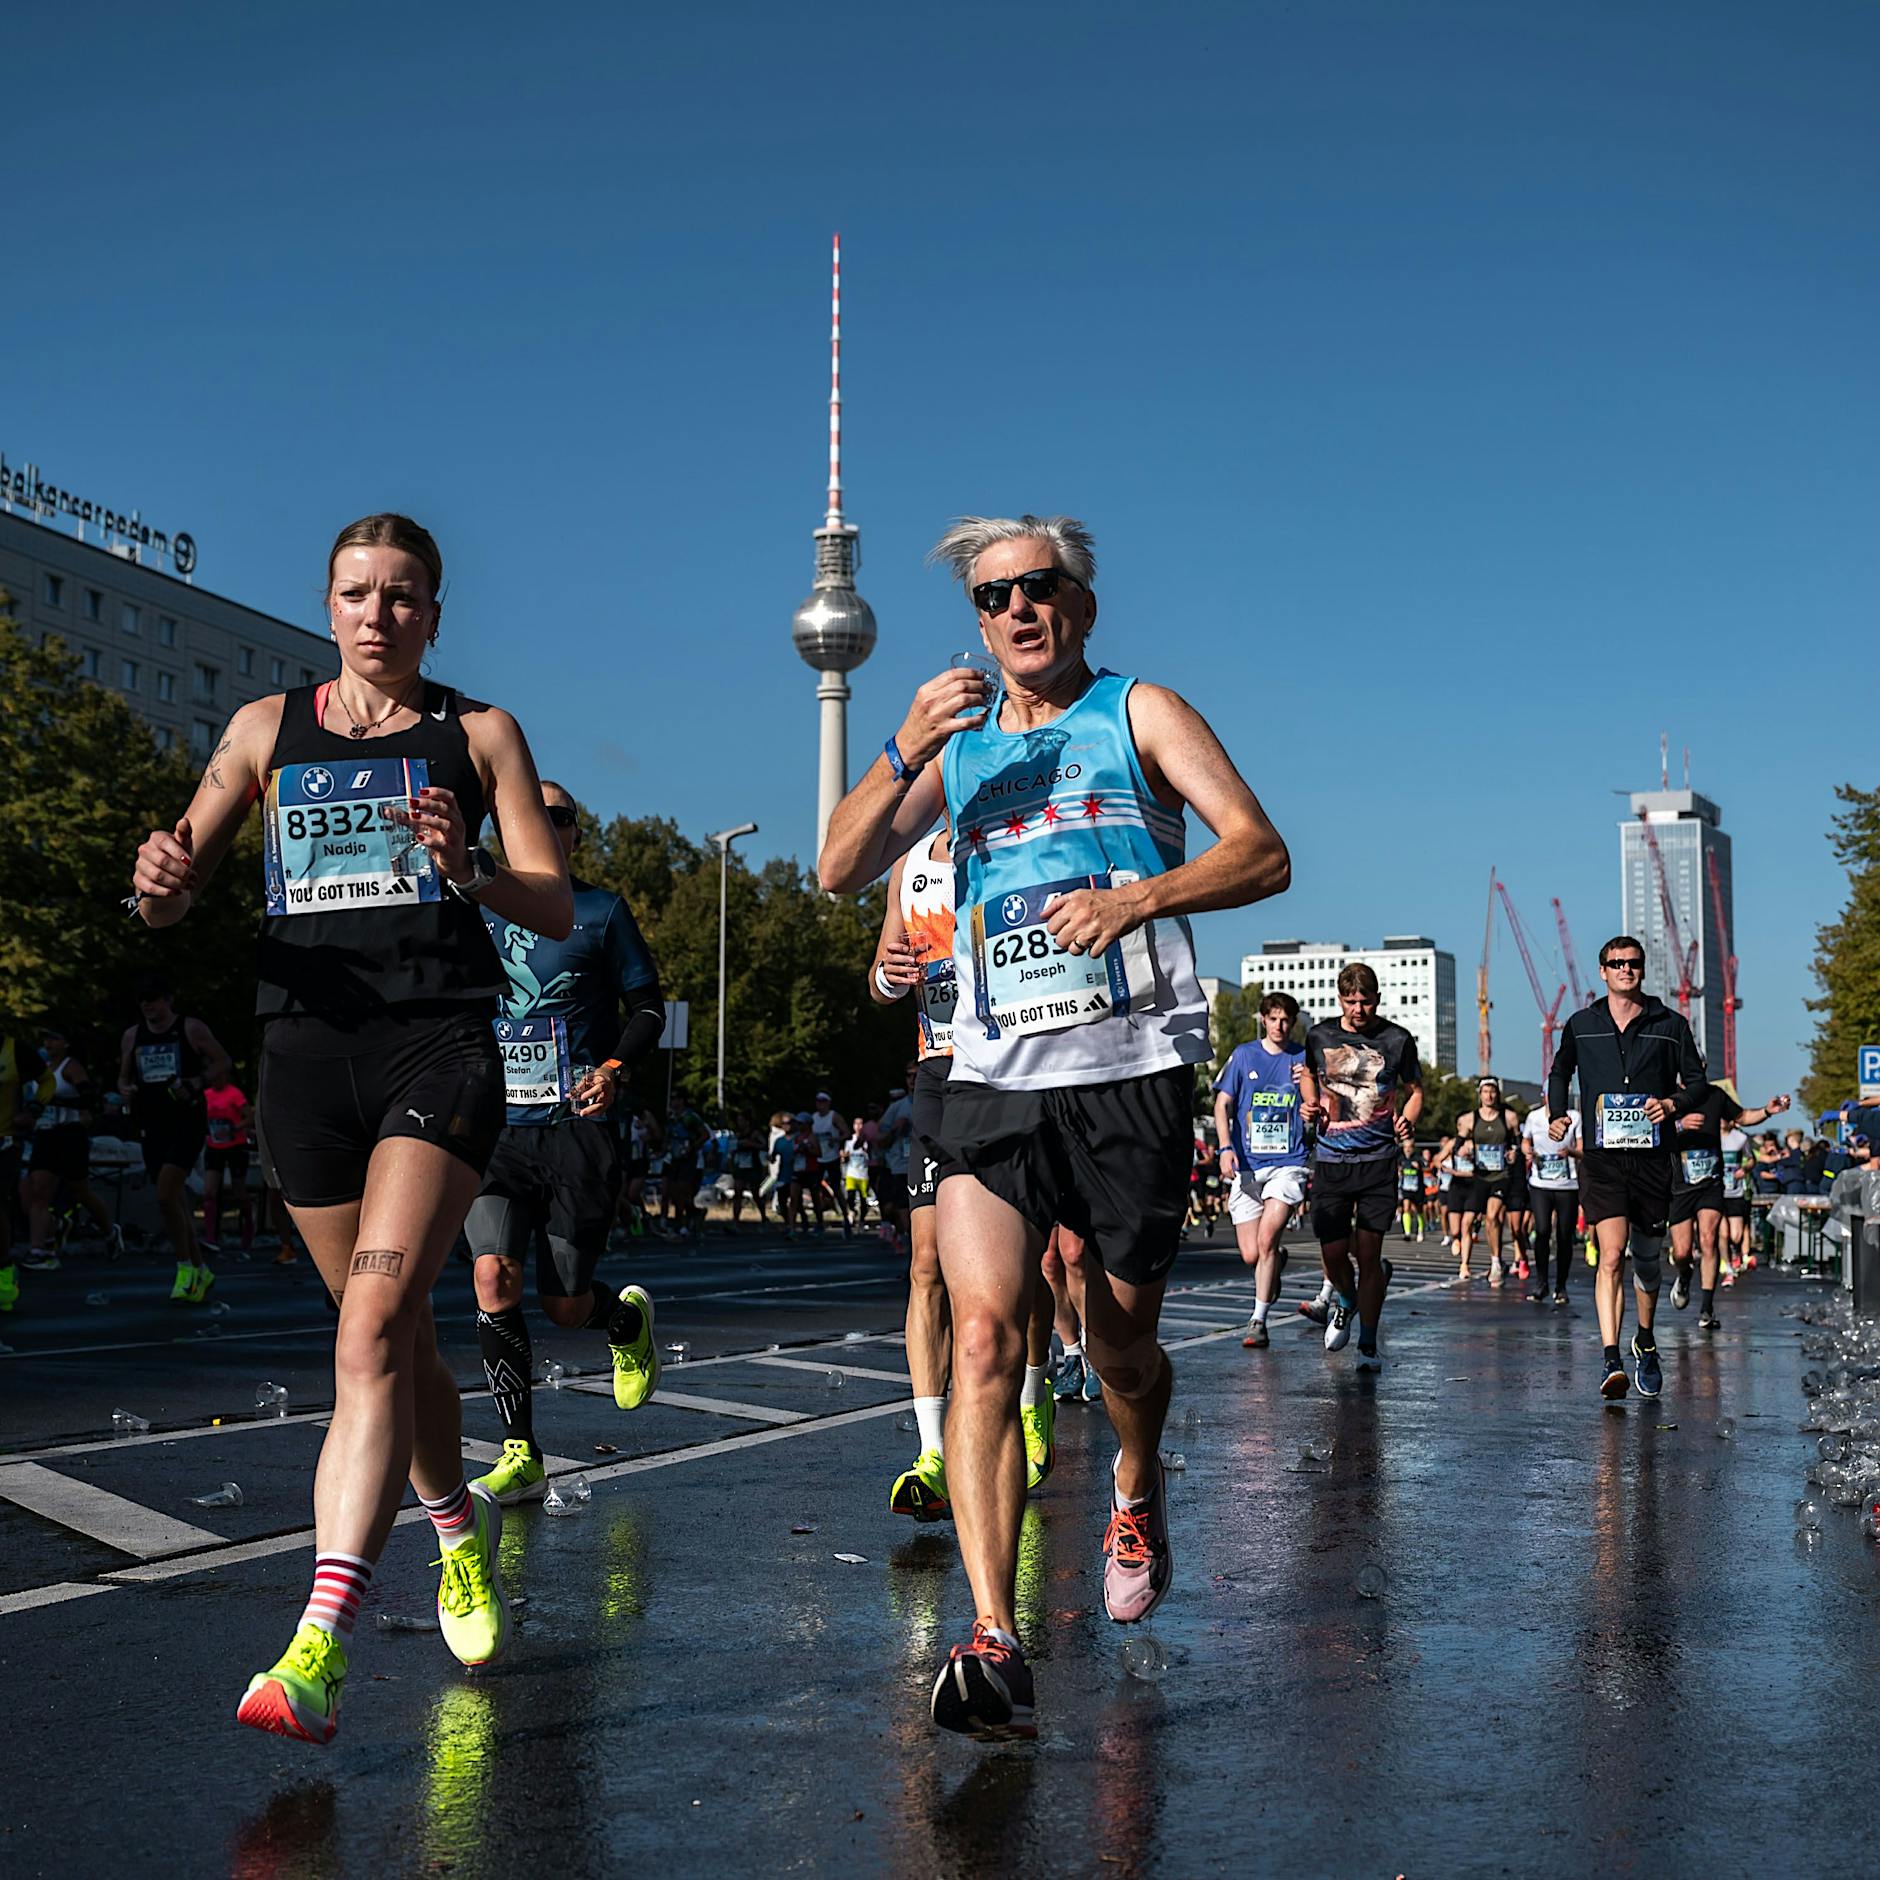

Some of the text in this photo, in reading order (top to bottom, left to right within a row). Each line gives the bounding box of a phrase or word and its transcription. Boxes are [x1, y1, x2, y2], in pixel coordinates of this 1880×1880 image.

[977, 763, 1082, 802] CHICAGO
[323, 842, 367, 857] Nadja
[930, 877, 943, 885] NN
[289, 881, 380, 904] YOU GOT THIS
[1019, 962, 1067, 983] Joseph
[1086, 973, 1095, 984] E
[1020, 1006, 1044, 1024] GOT
[1046, 999, 1079, 1019] THIS
[934, 1030, 946, 1042] YOU
[506, 1065, 532, 1075] Stefan
[519, 1088, 538, 1098] THIS
[1251, 1092, 1297, 1107] BERLIN
[1256, 1124, 1284, 1133] 26241
[1615, 1137, 1627, 1145] GOT
[1626, 1137, 1639, 1145] THIS
[352, 1253, 398, 1272] KRAFT
